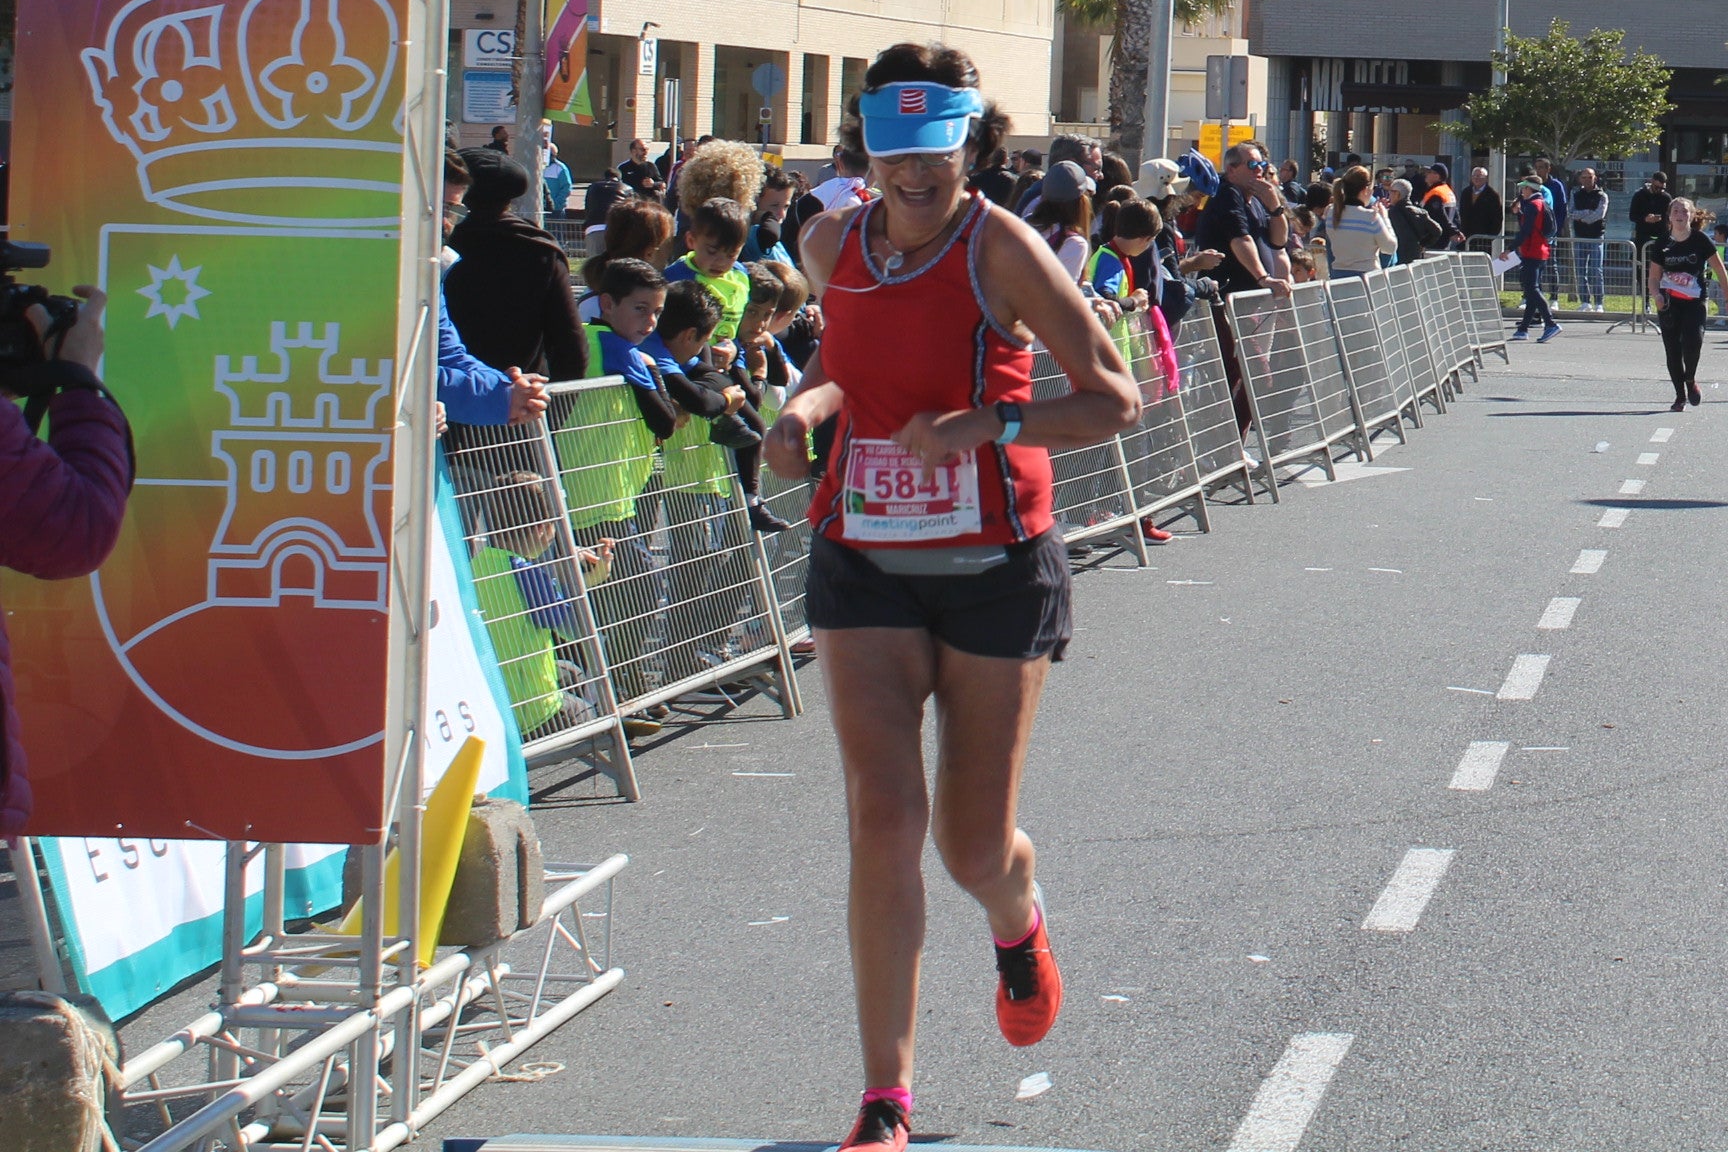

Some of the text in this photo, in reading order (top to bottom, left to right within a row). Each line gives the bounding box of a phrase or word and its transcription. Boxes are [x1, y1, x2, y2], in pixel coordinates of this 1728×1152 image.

[1311, 58, 1345, 111] MR
[875, 469, 940, 500] 584
[885, 503, 929, 515] MARICRUZ
